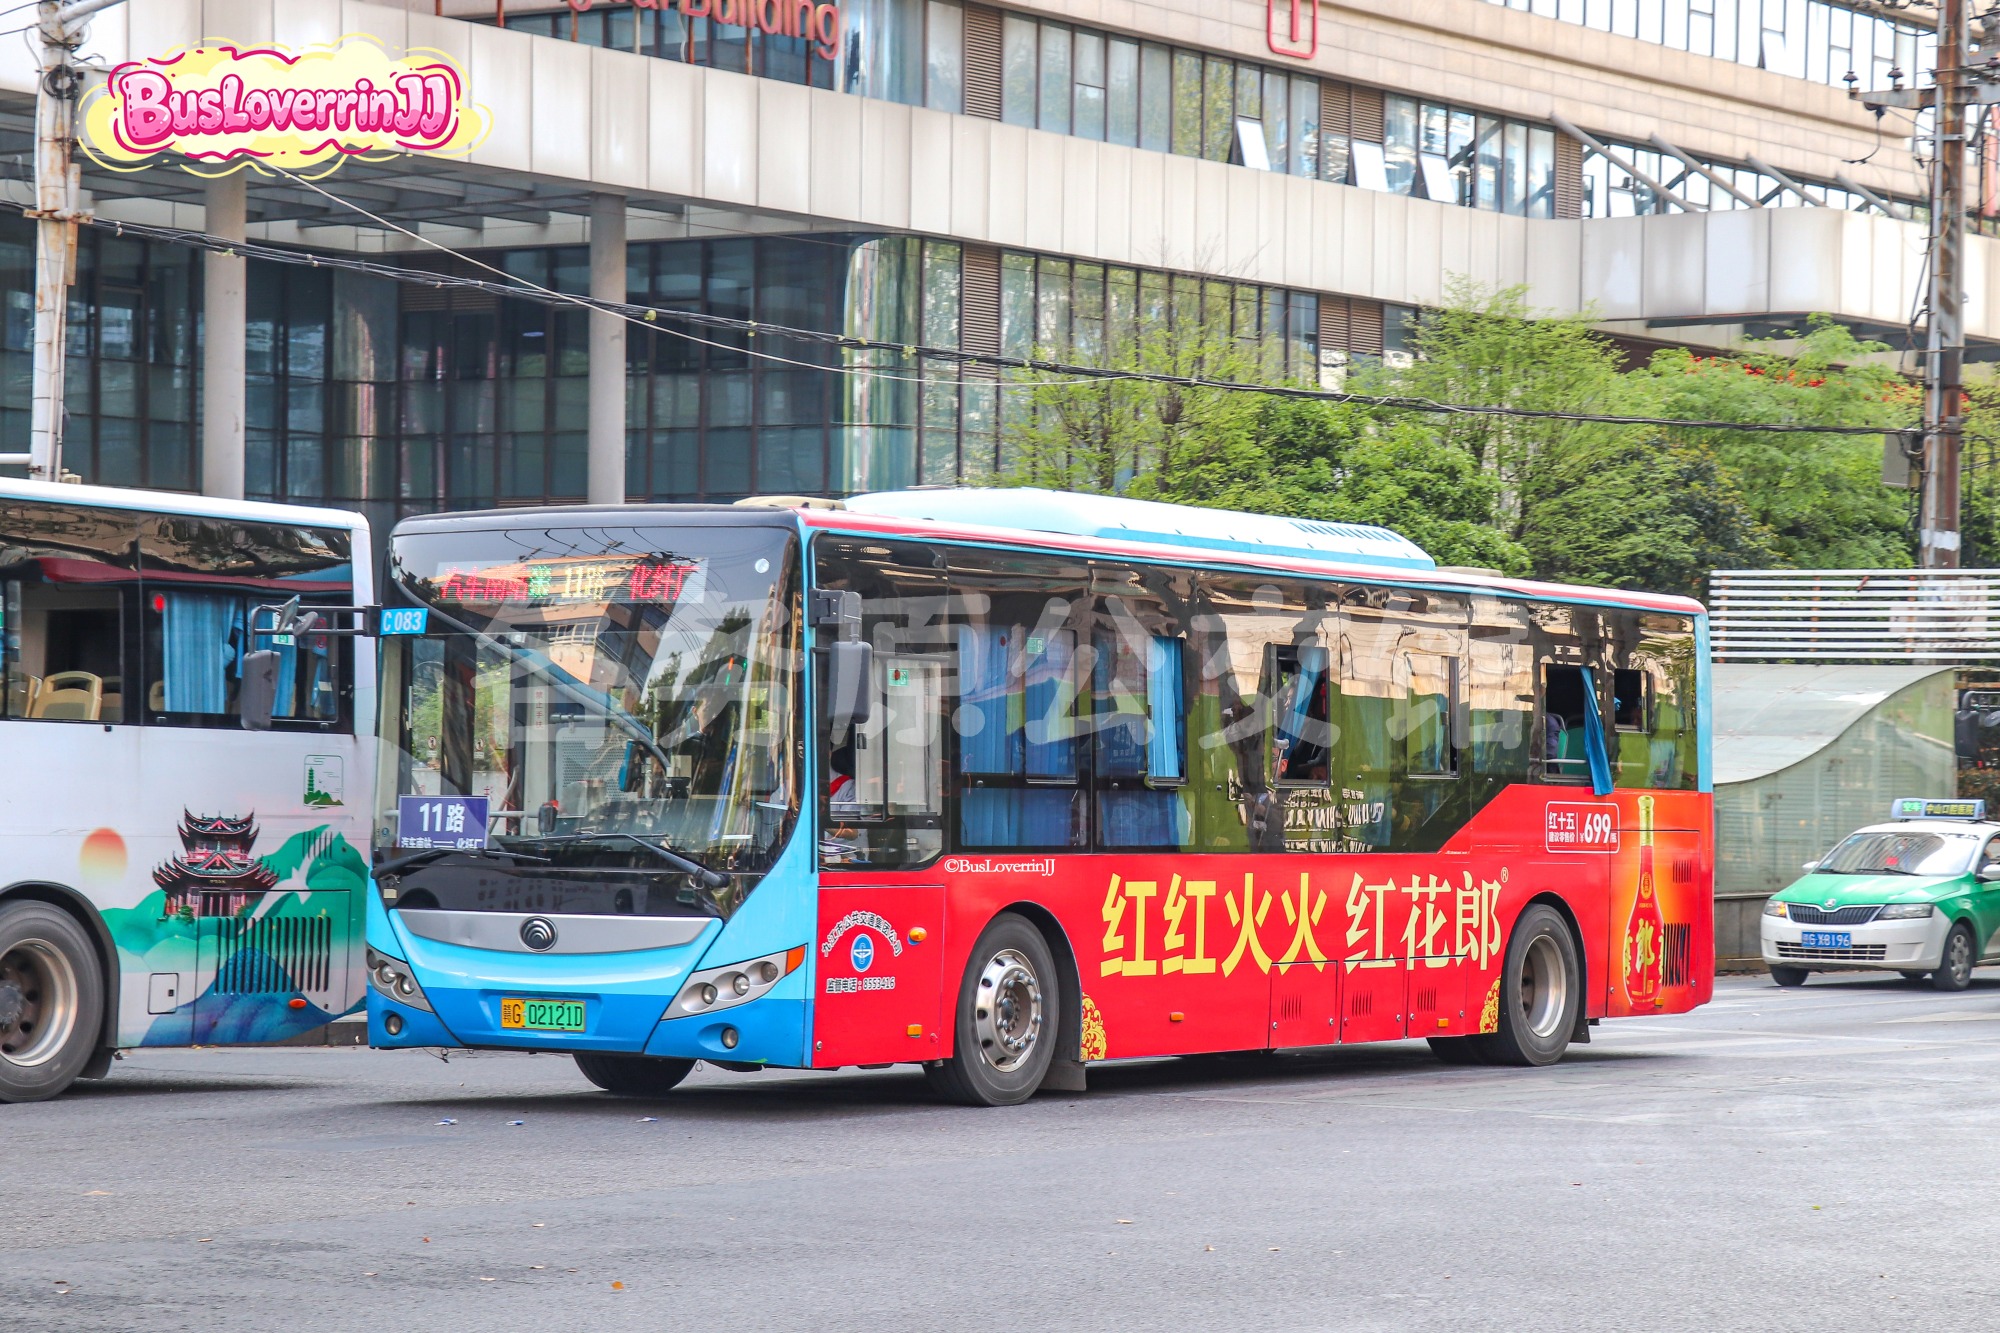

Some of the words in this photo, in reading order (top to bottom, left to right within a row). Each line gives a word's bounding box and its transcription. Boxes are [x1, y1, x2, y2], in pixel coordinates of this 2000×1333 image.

[680, 0, 839, 60] uilding
[561, 566, 606, 600] 11路
[629, 565, 700, 600] 化纤厂
[419, 803, 466, 832] 11路
[1549, 812, 1575, 830] 红十五
[1902, 801, 1921, 812] 空车
[1926, 804, 1975, 815] 中山口腔医院
[1549, 832, 1575, 842] 建议零售价
[821, 910, 903, 957] 九江市公共交通集团公司
[1101, 872, 1328, 978] 红红火火
